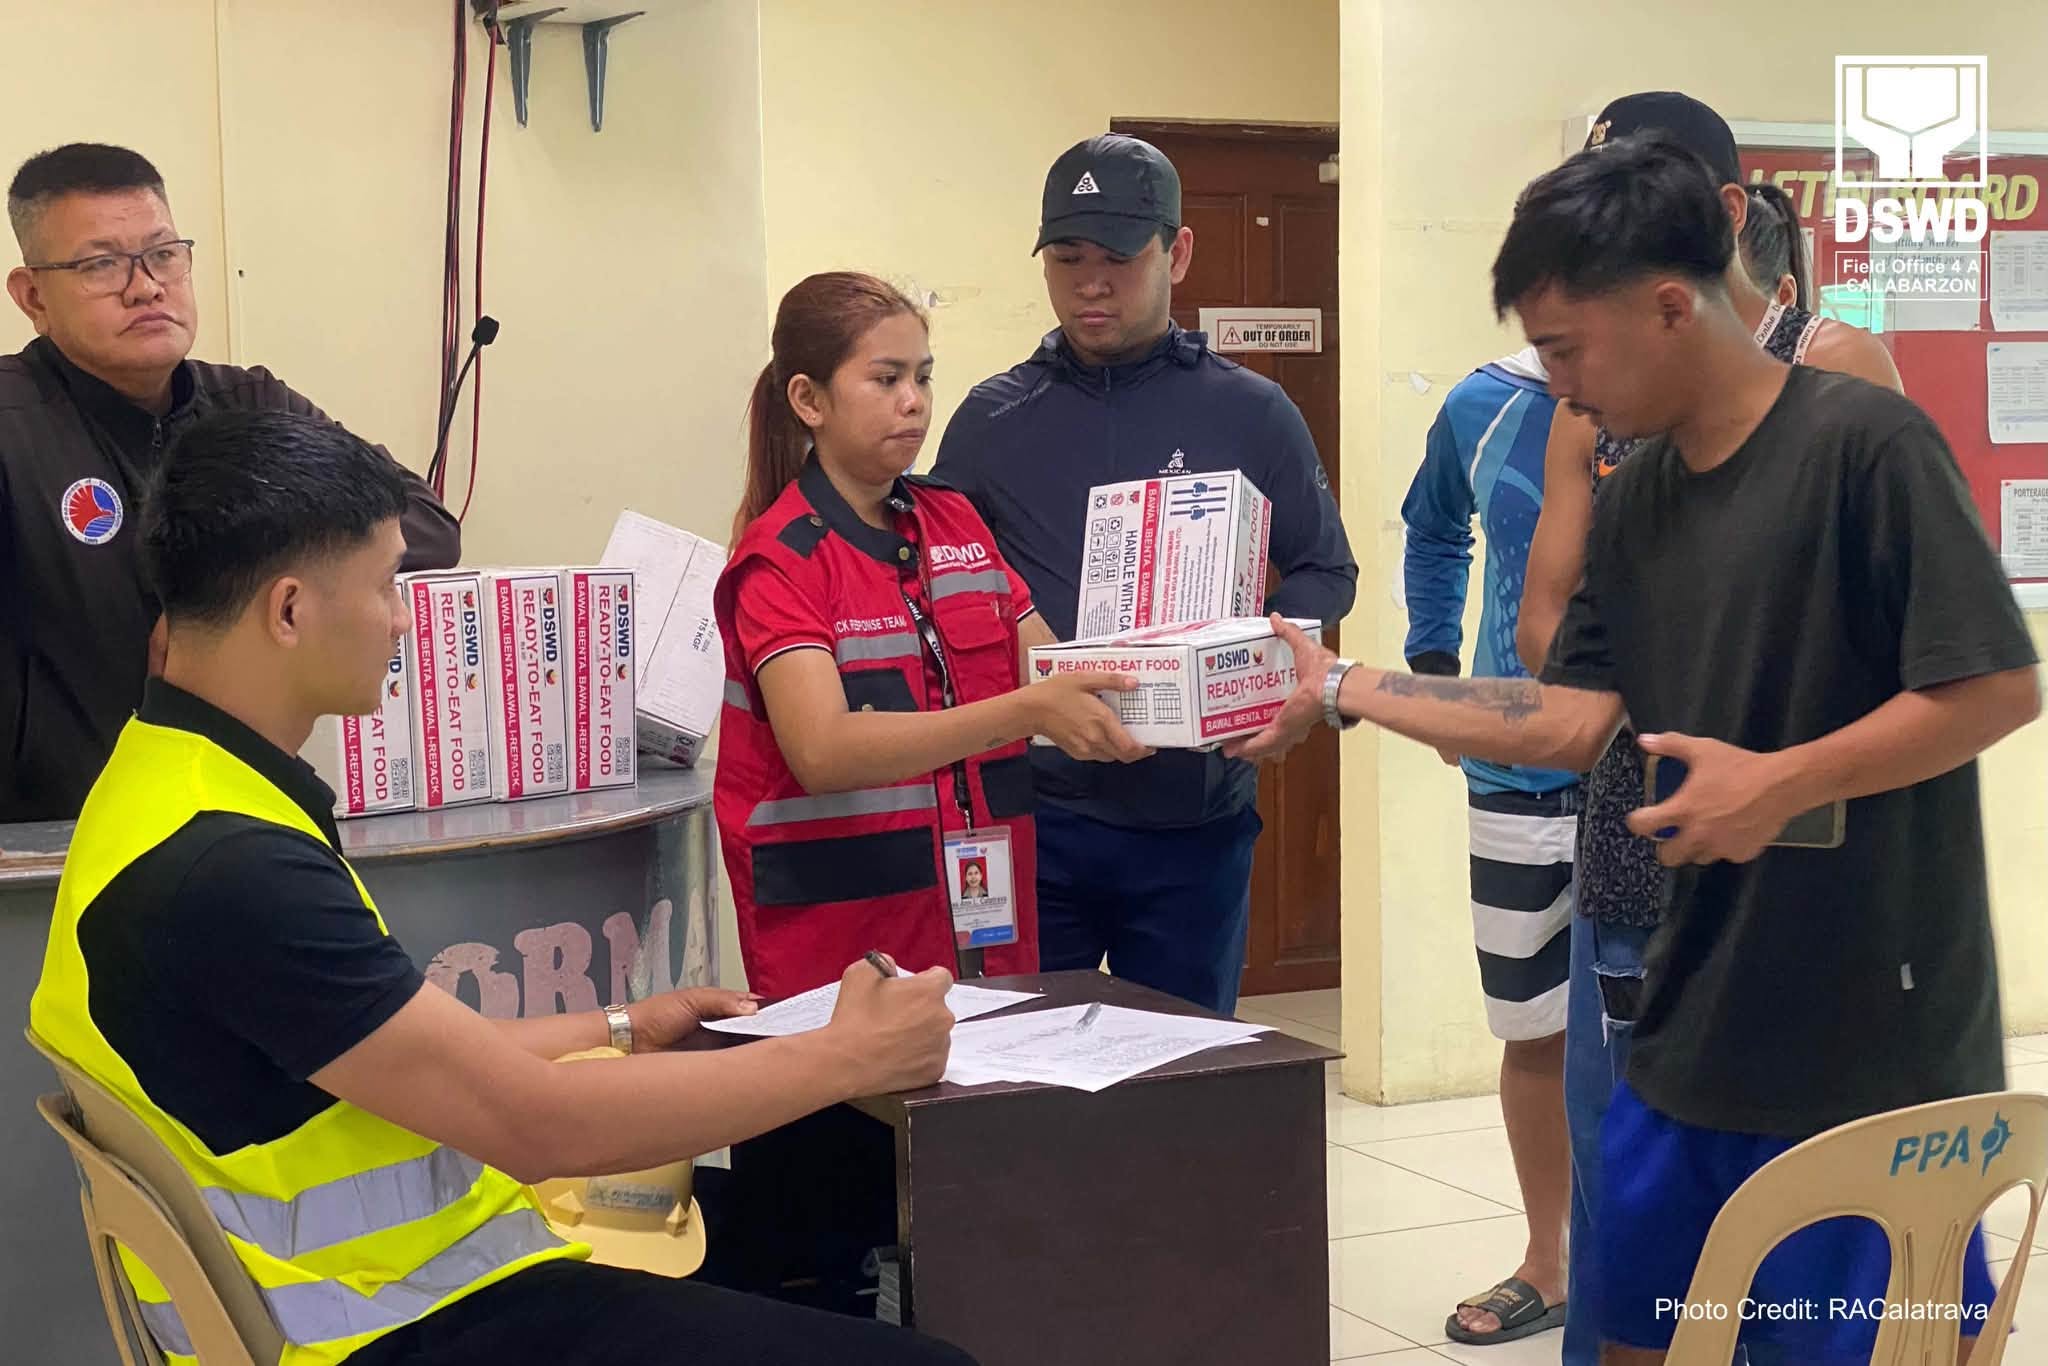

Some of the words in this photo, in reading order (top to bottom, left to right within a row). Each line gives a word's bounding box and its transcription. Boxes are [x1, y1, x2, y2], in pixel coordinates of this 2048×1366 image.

[1243, 331, 1262, 342] OUT
[1265, 331, 1278, 342] OF
[1279, 331, 1311, 342] ORDER
[1145, 489, 1157, 526] BAWAL
[1249, 497, 1259, 545] FOOD
[1123, 530, 1138, 579] HANDLE
[417, 589, 430, 635] BAWAL
[500, 586, 511, 629] BAWAL
[577, 581, 587, 624] BAWAL
[1120, 581, 1134, 612] WITH
[1139, 572, 1150, 609] BAWAL
[464, 610, 479, 666] DSWD
[543, 608, 558, 662] DSWD
[618, 604, 630, 657] DSWD
[692, 631, 704, 650] KGF
[882, 615, 907, 629] TEAM
[421, 637, 433, 686] IBENTA.
[441, 592, 462, 731] READY-TO-EAT
[503, 633, 514, 681] IBENTA.
[523, 589, 542, 726] READY-TO-EAT
[578, 627, 587, 673] IBENTA.
[599, 585, 611, 719] READY-TO-EAT
[1058, 660, 1142, 672] READY-TO-EAT
[1146, 659, 1181, 671] FOOD
[1217, 649, 1249, 669] DSWD
[506, 683, 517, 728] BAWAL
[578, 676, 588, 719] BAWAL
[1207, 669, 1287, 700] READY-TO-EAT
[425, 689, 436, 733] BAWAL
[1205, 716, 1233, 733] BAWAL
[427, 736, 440, 797] I-REPACK.
[450, 737, 465, 791] FOOD
[531, 732, 545, 783] FOOD
[600, 724, 612, 775] FOOD
[373, 746, 388, 800] FOOD
[1889, 1125, 1970, 1176] PPA
